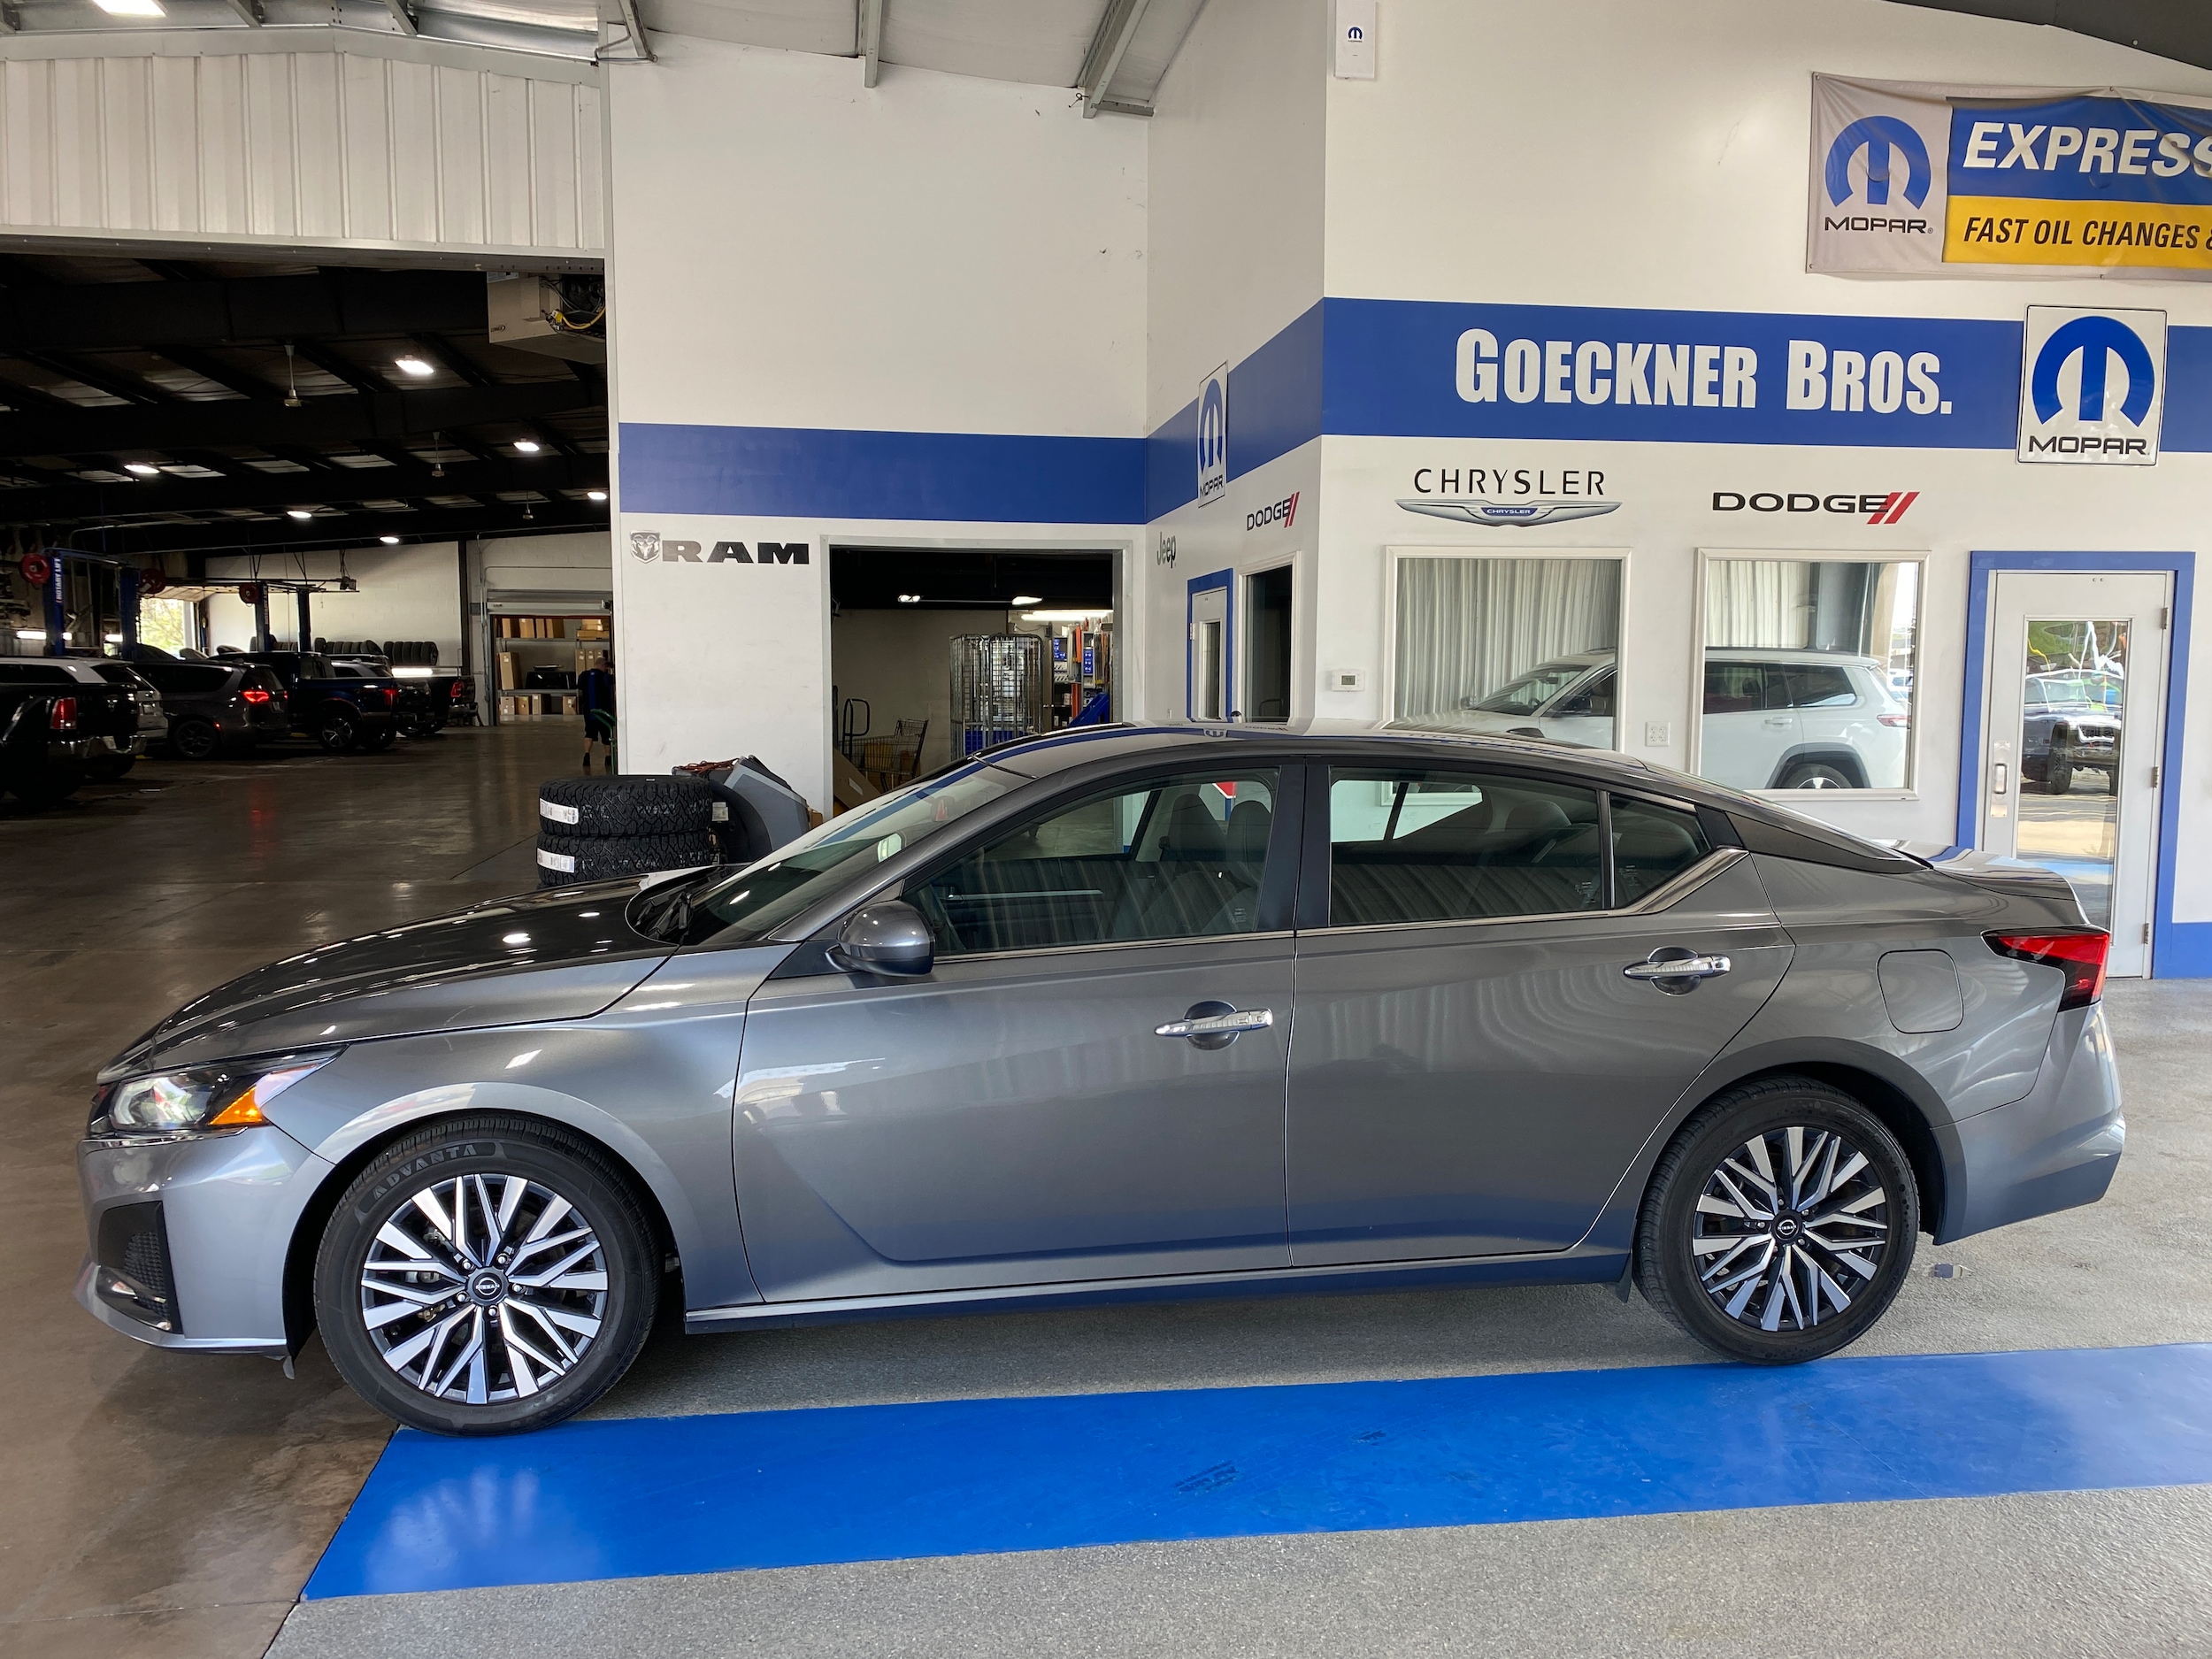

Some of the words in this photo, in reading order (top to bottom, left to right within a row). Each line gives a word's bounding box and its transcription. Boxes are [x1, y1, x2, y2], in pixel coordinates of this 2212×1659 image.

[1824, 216, 1927, 234] MOPAR
[1963, 217, 2030, 244] FAST
[2034, 219, 2073, 244] OIL
[2082, 220, 2200, 249] CHANGES
[1455, 327, 1758, 409] GOECKNER
[1786, 339, 1952, 414] BROS.
[2029, 435, 2147, 456] MOPAR
[1200, 474, 1224, 497] MOPAR
[1413, 468, 1605, 495] CHRYSLER
[1247, 497, 1291, 531] DODGE
[1712, 492, 1889, 513] DODGE
[662, 540, 810, 565] RAM
[1156, 531, 1176, 568] Jeep
[373, 1144, 478, 1201] ADVANTA
